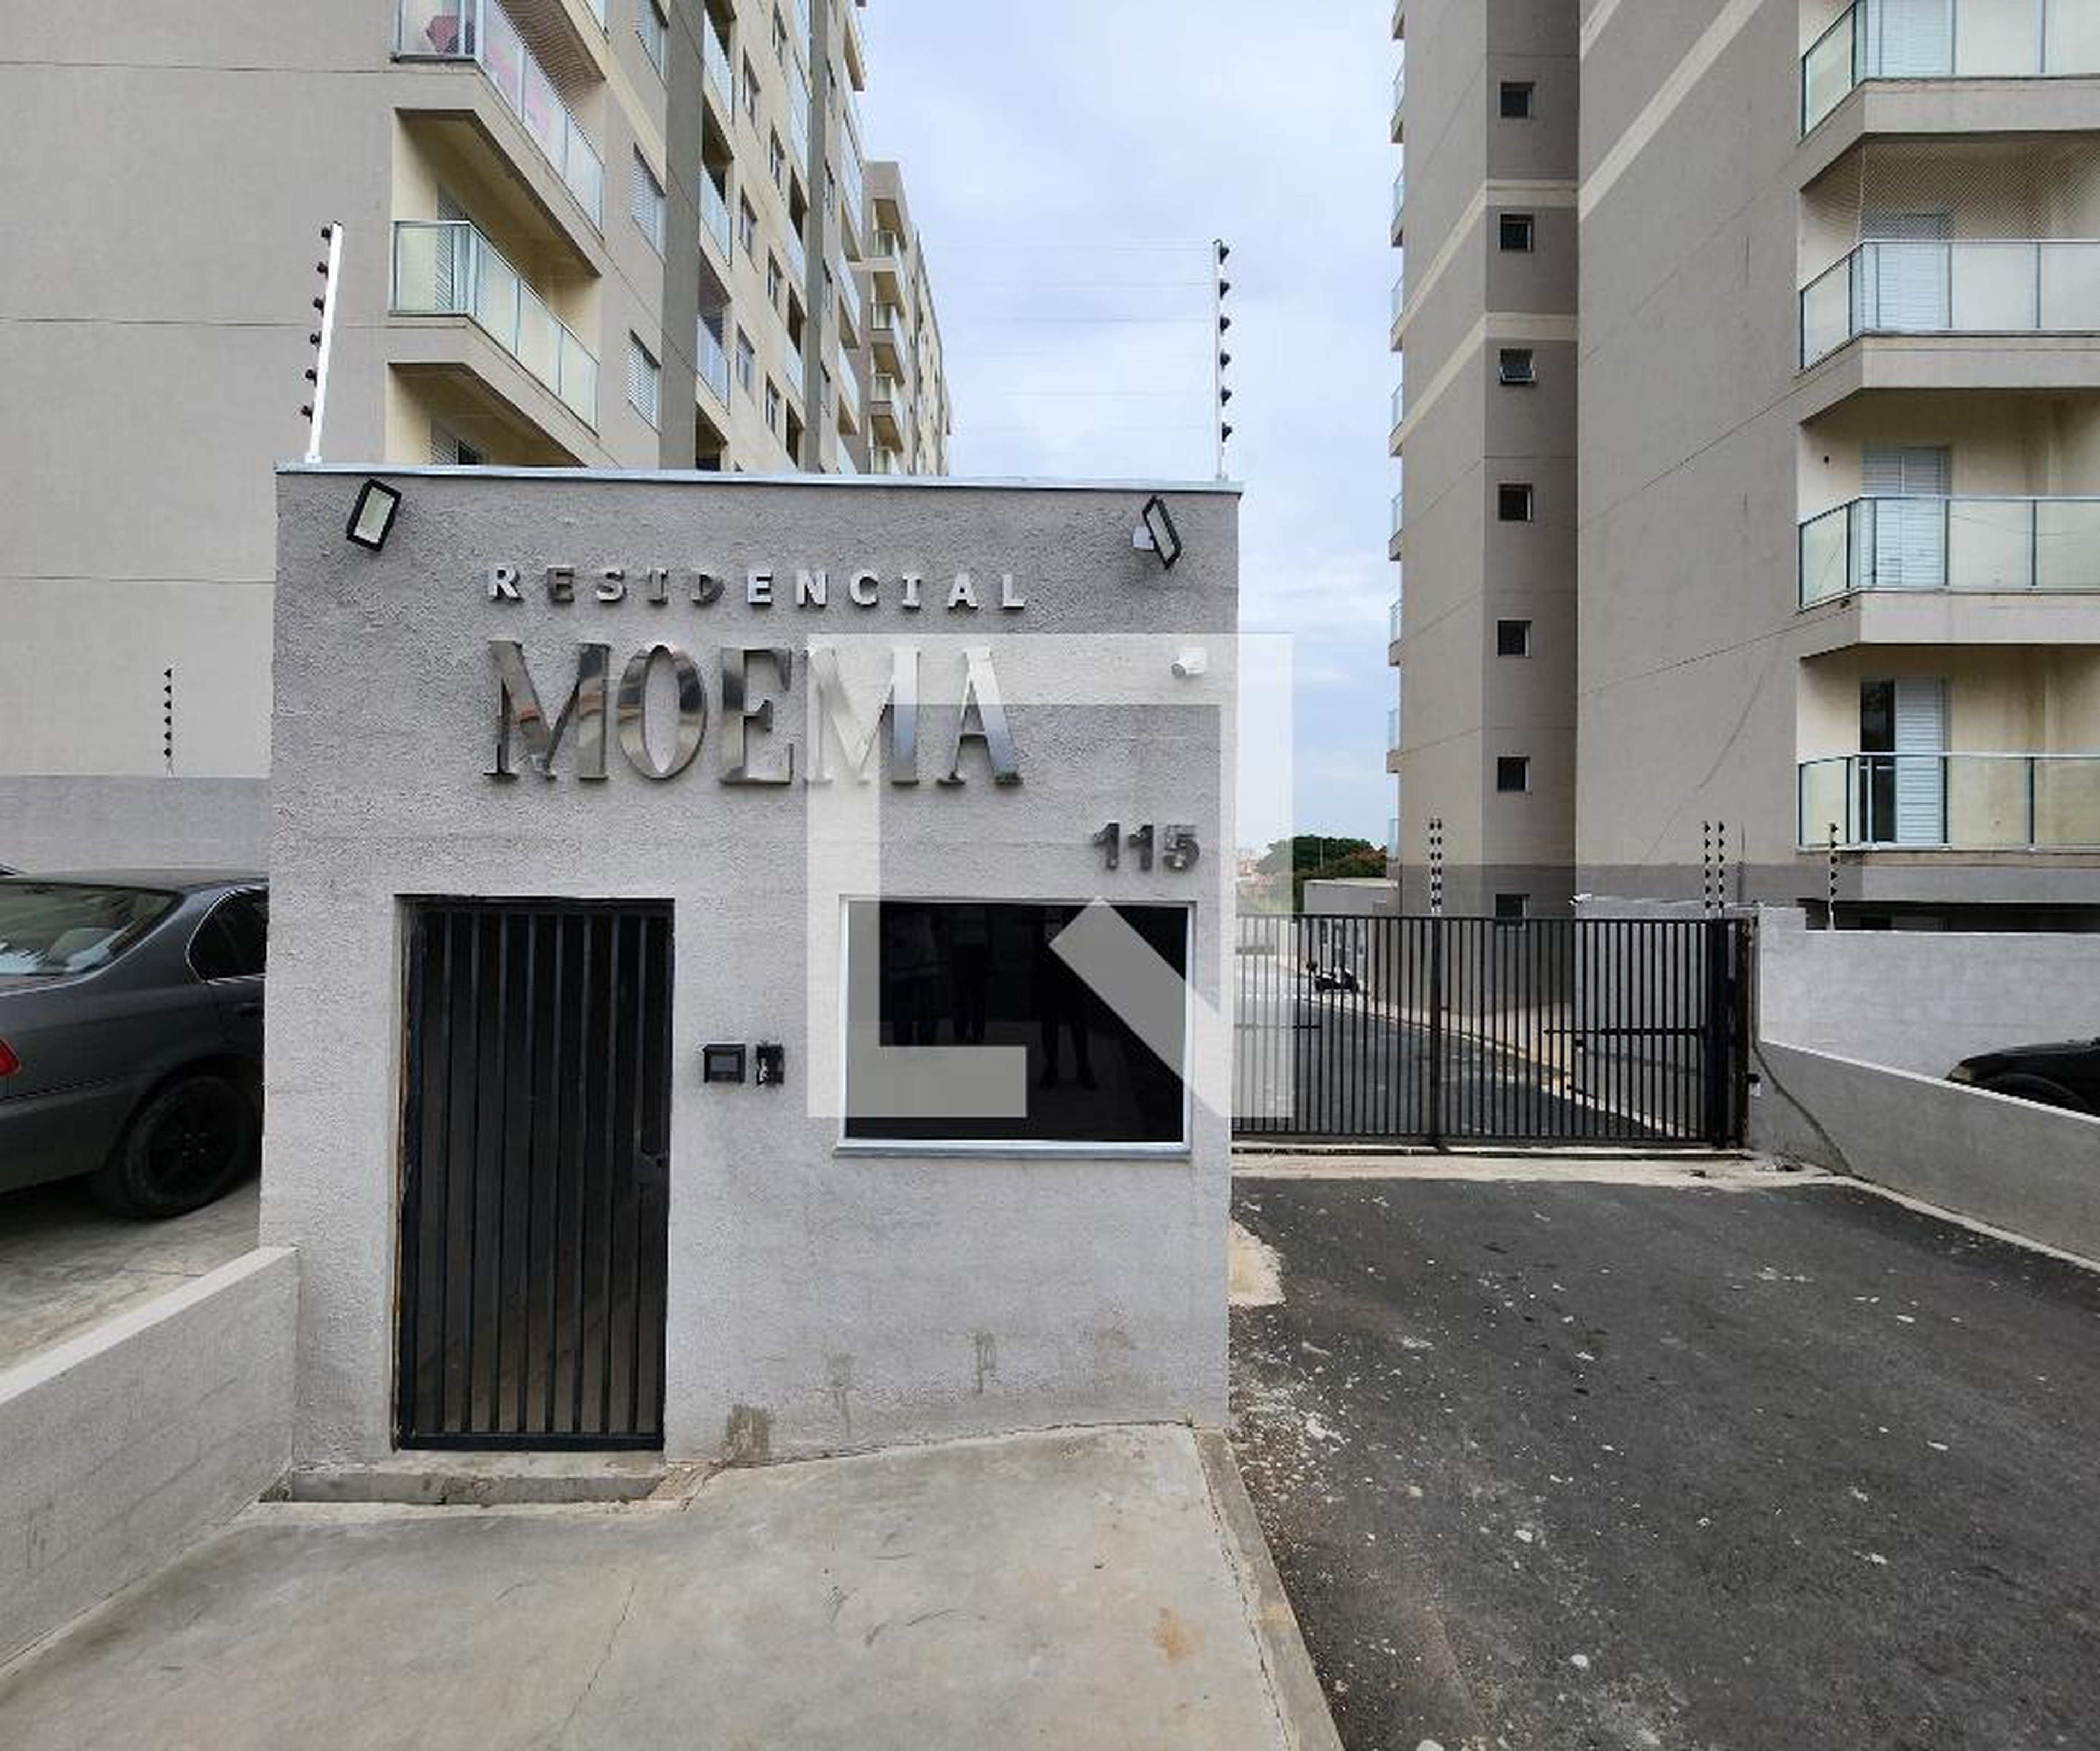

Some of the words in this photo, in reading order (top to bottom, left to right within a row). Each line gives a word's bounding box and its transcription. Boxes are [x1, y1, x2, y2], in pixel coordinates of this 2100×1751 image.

[488, 564, 1026, 611] RESIDENCIAL
[483, 639, 1023, 786] MOEMA
[1093, 822, 1200, 872] 115
